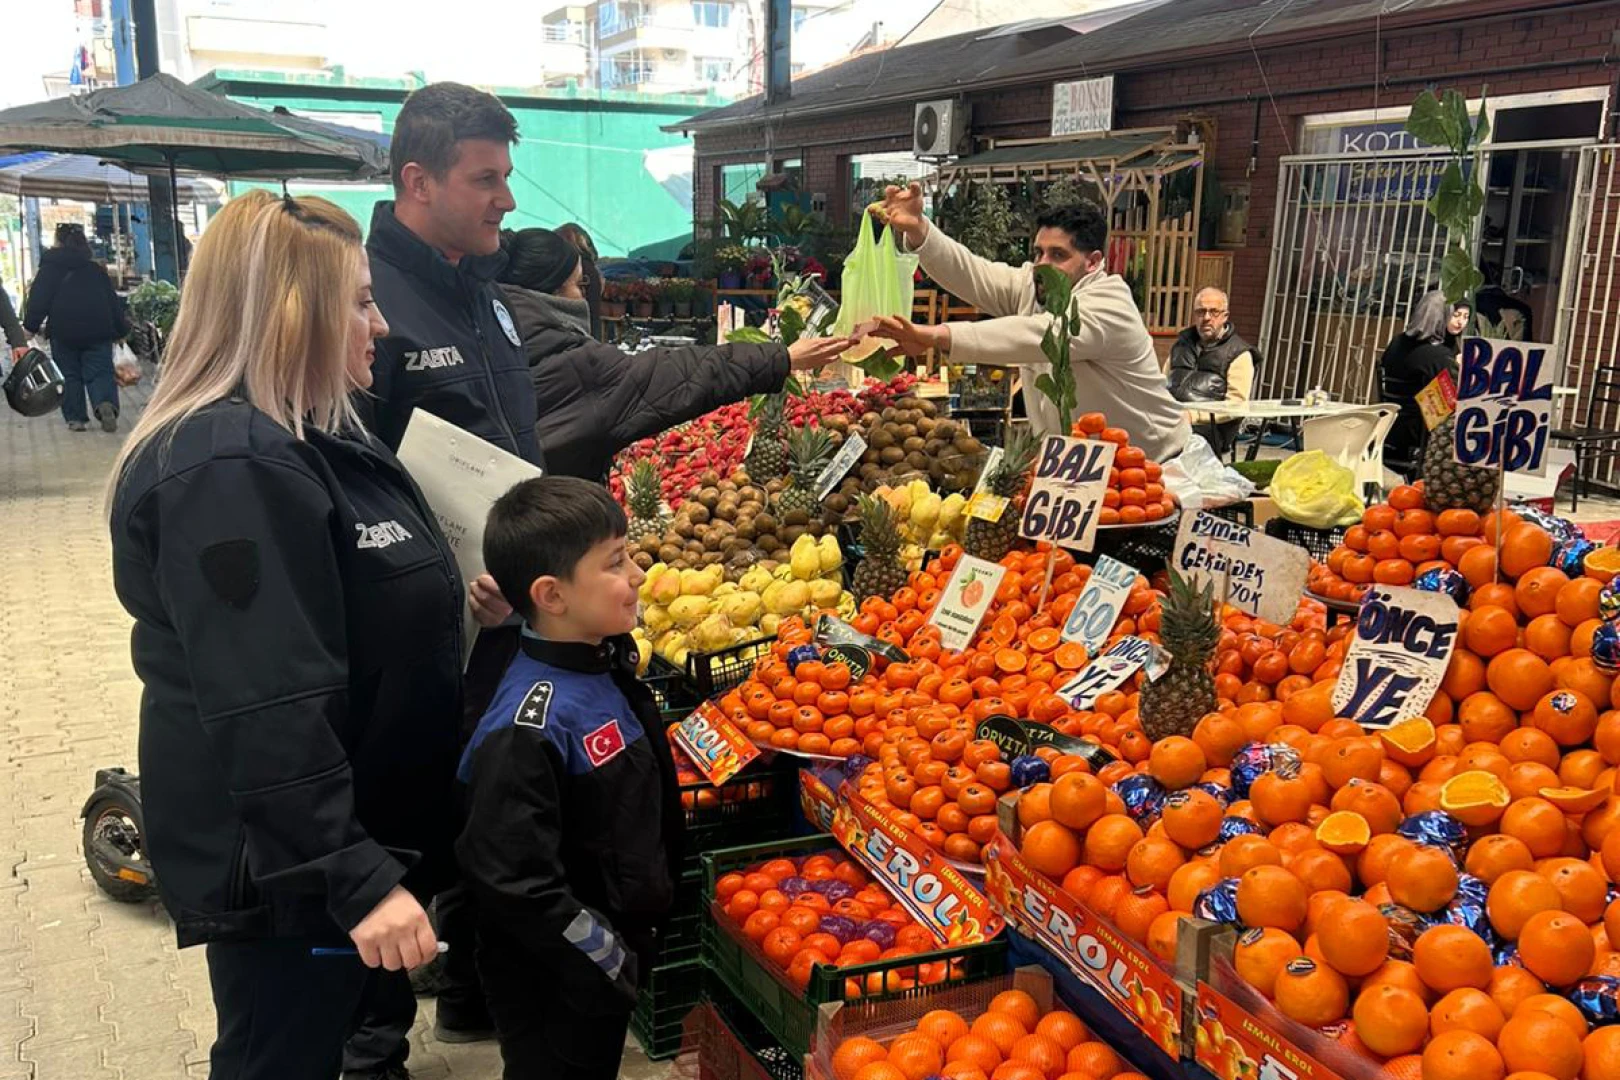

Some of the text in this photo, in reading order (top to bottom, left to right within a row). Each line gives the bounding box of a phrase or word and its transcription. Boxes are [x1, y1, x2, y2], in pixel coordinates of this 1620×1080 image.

[1458, 337, 1553, 400] BAL
[1037, 436, 1105, 482] BAL
[1066, 586, 1115, 639] 60
[1229, 582, 1262, 614] YOK
[1357, 591, 1458, 660] ÖNCE
[1059, 665, 1120, 700] YE
[1335, 658, 1423, 726] YE
[979, 725, 1028, 756] ORVITA
[1026, 728, 1055, 742] ITA
[866, 828, 959, 927] EROL
[1022, 884, 1132, 998] EROL
[1284, 1049, 1314, 1076] EROL
